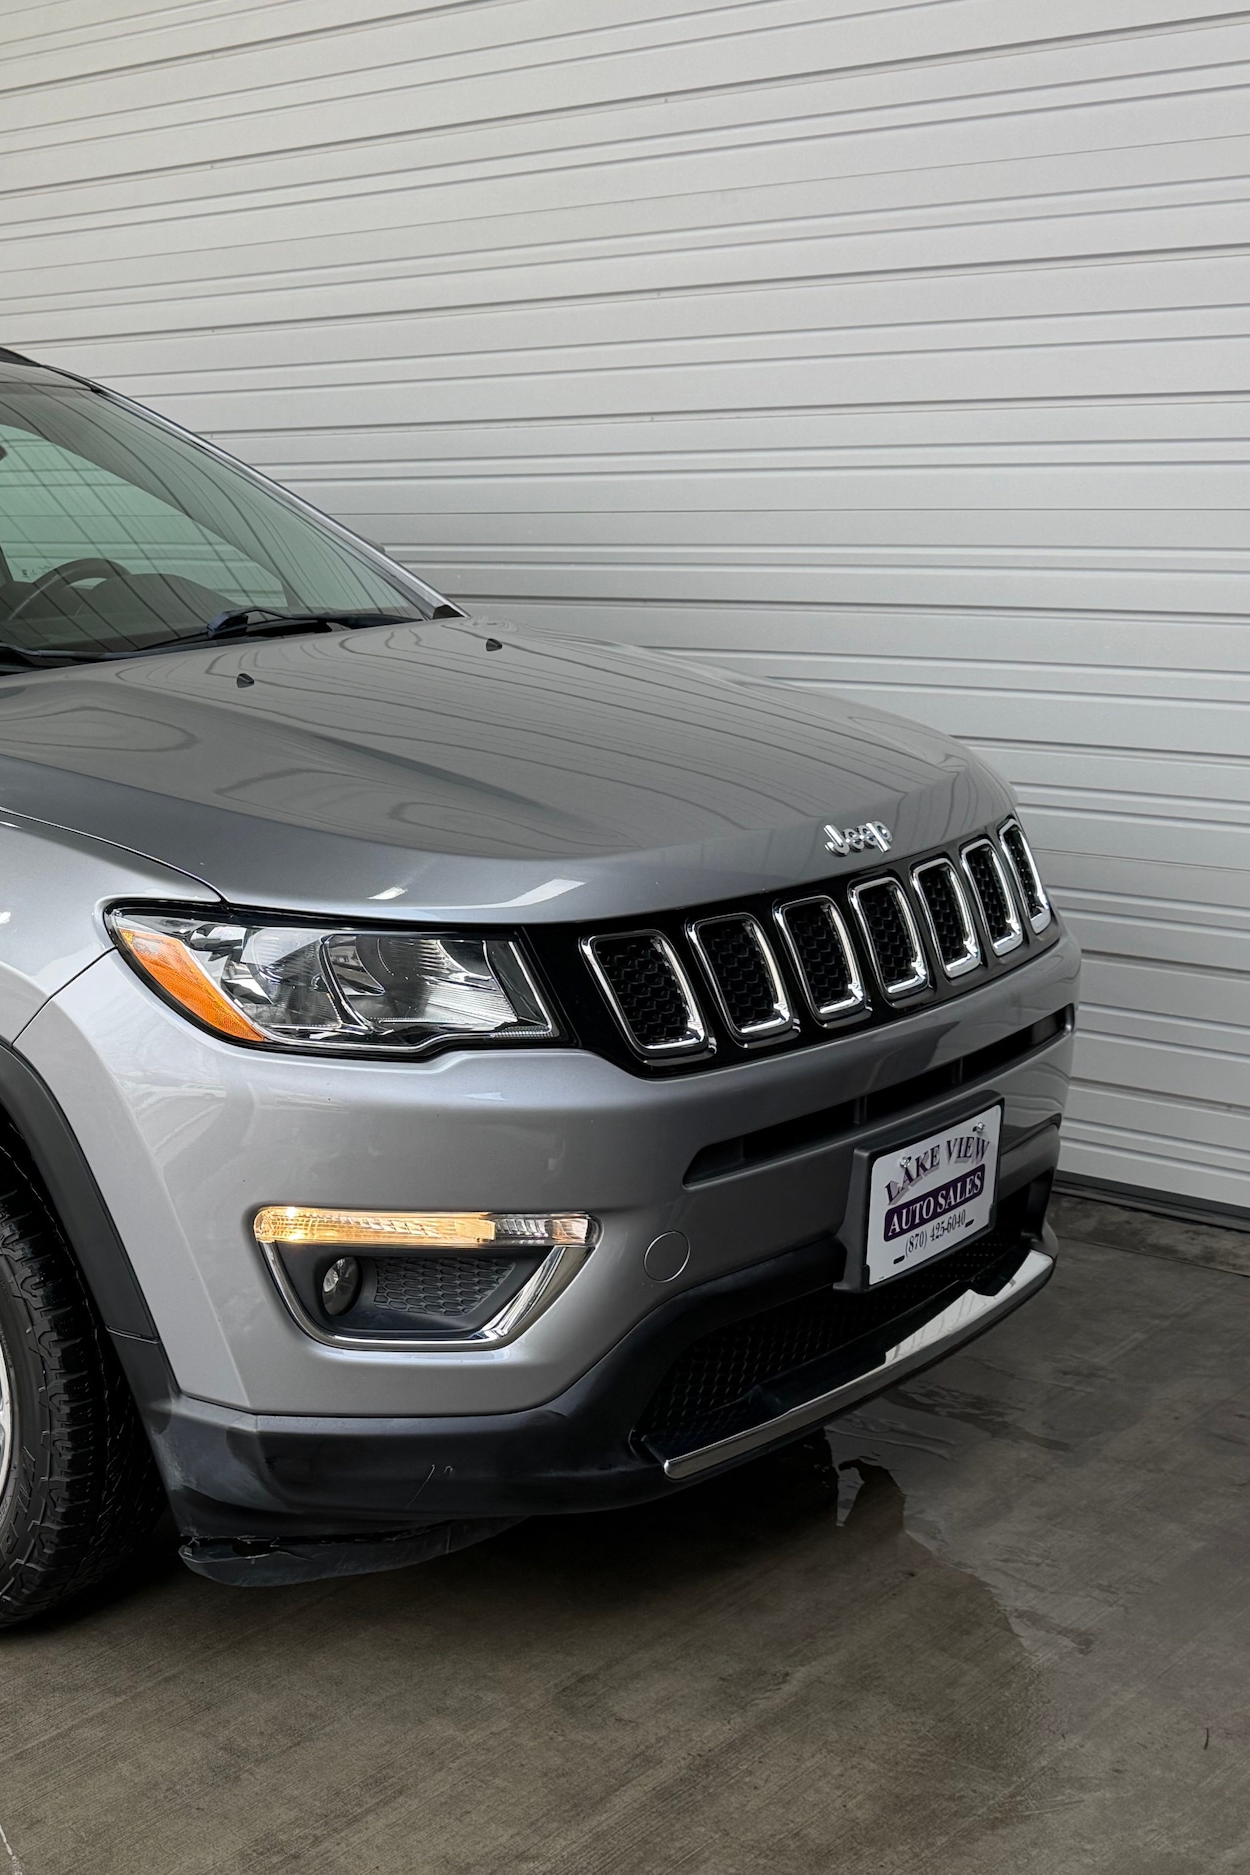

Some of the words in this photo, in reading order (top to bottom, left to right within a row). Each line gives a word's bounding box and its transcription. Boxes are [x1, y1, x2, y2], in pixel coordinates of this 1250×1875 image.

[823, 821, 892, 856] Jeep
[884, 1144, 941, 1204] LAKE
[946, 1136, 991, 1165] VIEW
[887, 1197, 935, 1237] AUTO
[936, 1171, 983, 1213] SALES
[904, 1229, 928, 1258] (870)
[930, 1208, 967, 1242] 425-6040
